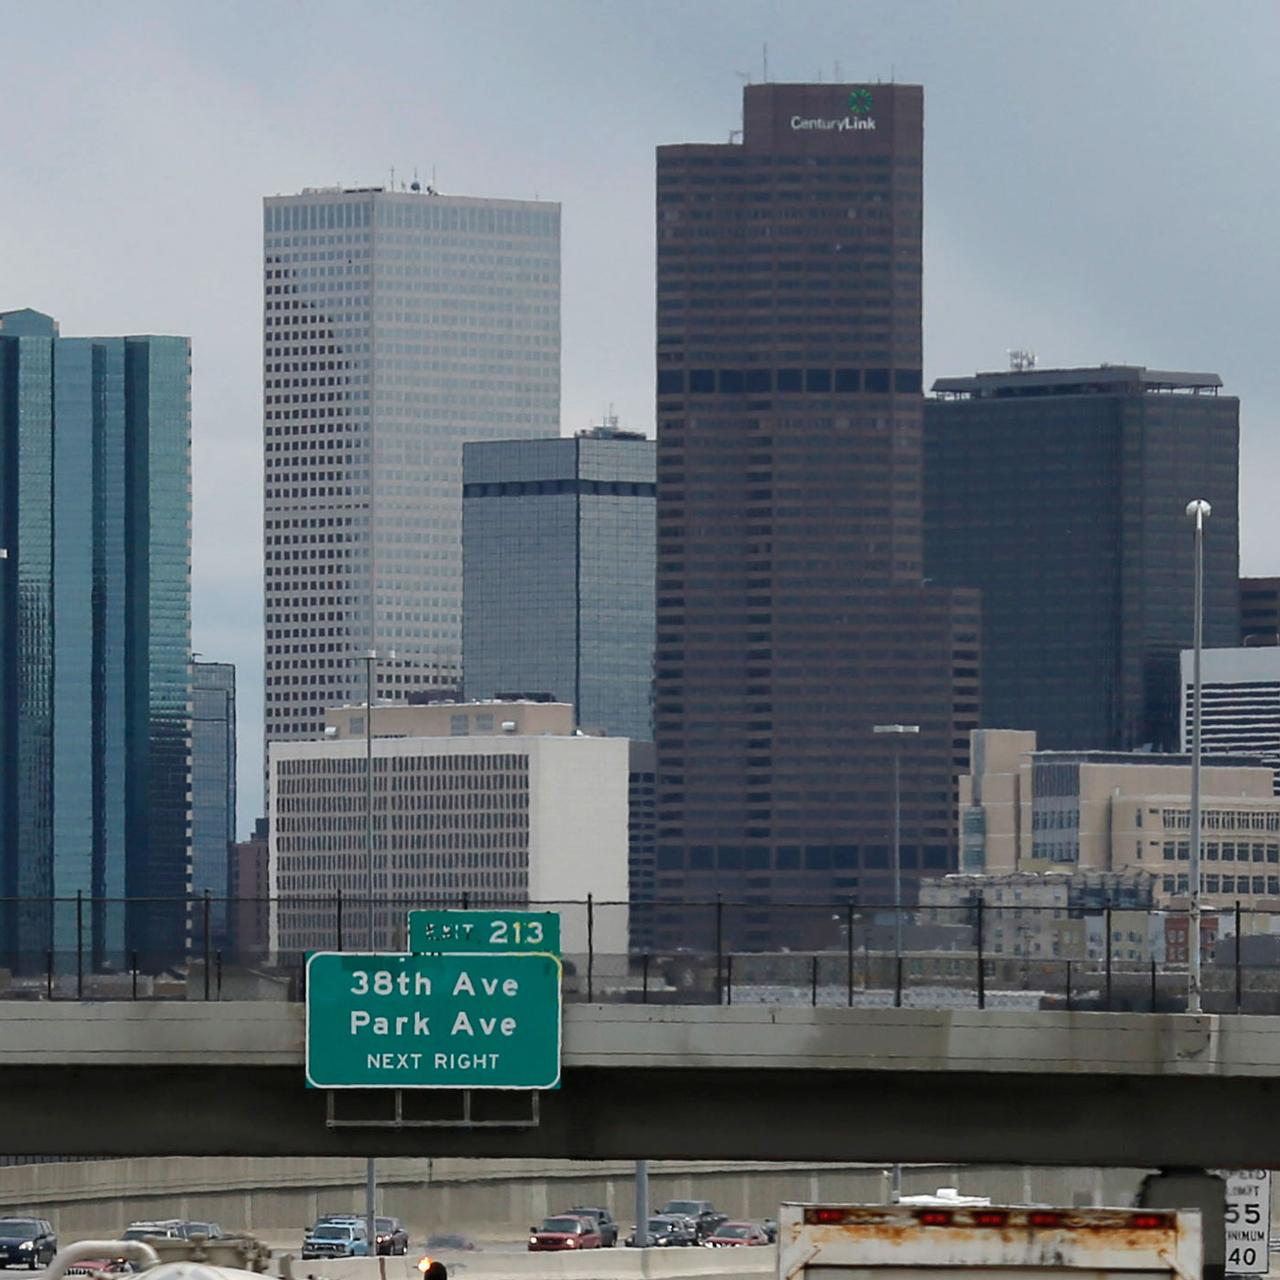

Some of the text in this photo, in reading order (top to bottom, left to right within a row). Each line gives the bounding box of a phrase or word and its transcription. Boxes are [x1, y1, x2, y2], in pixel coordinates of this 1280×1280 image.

[790, 116, 876, 132] CenturyLink
[489, 920, 544, 944] 213
[350, 970, 519, 997] 38th Ave
[350, 1010, 517, 1037] Park Ave
[367, 1053, 499, 1070] NEXT RIGHT
[1225, 1203, 1260, 1224] 55
[1228, 1248, 1256, 1266] 40
